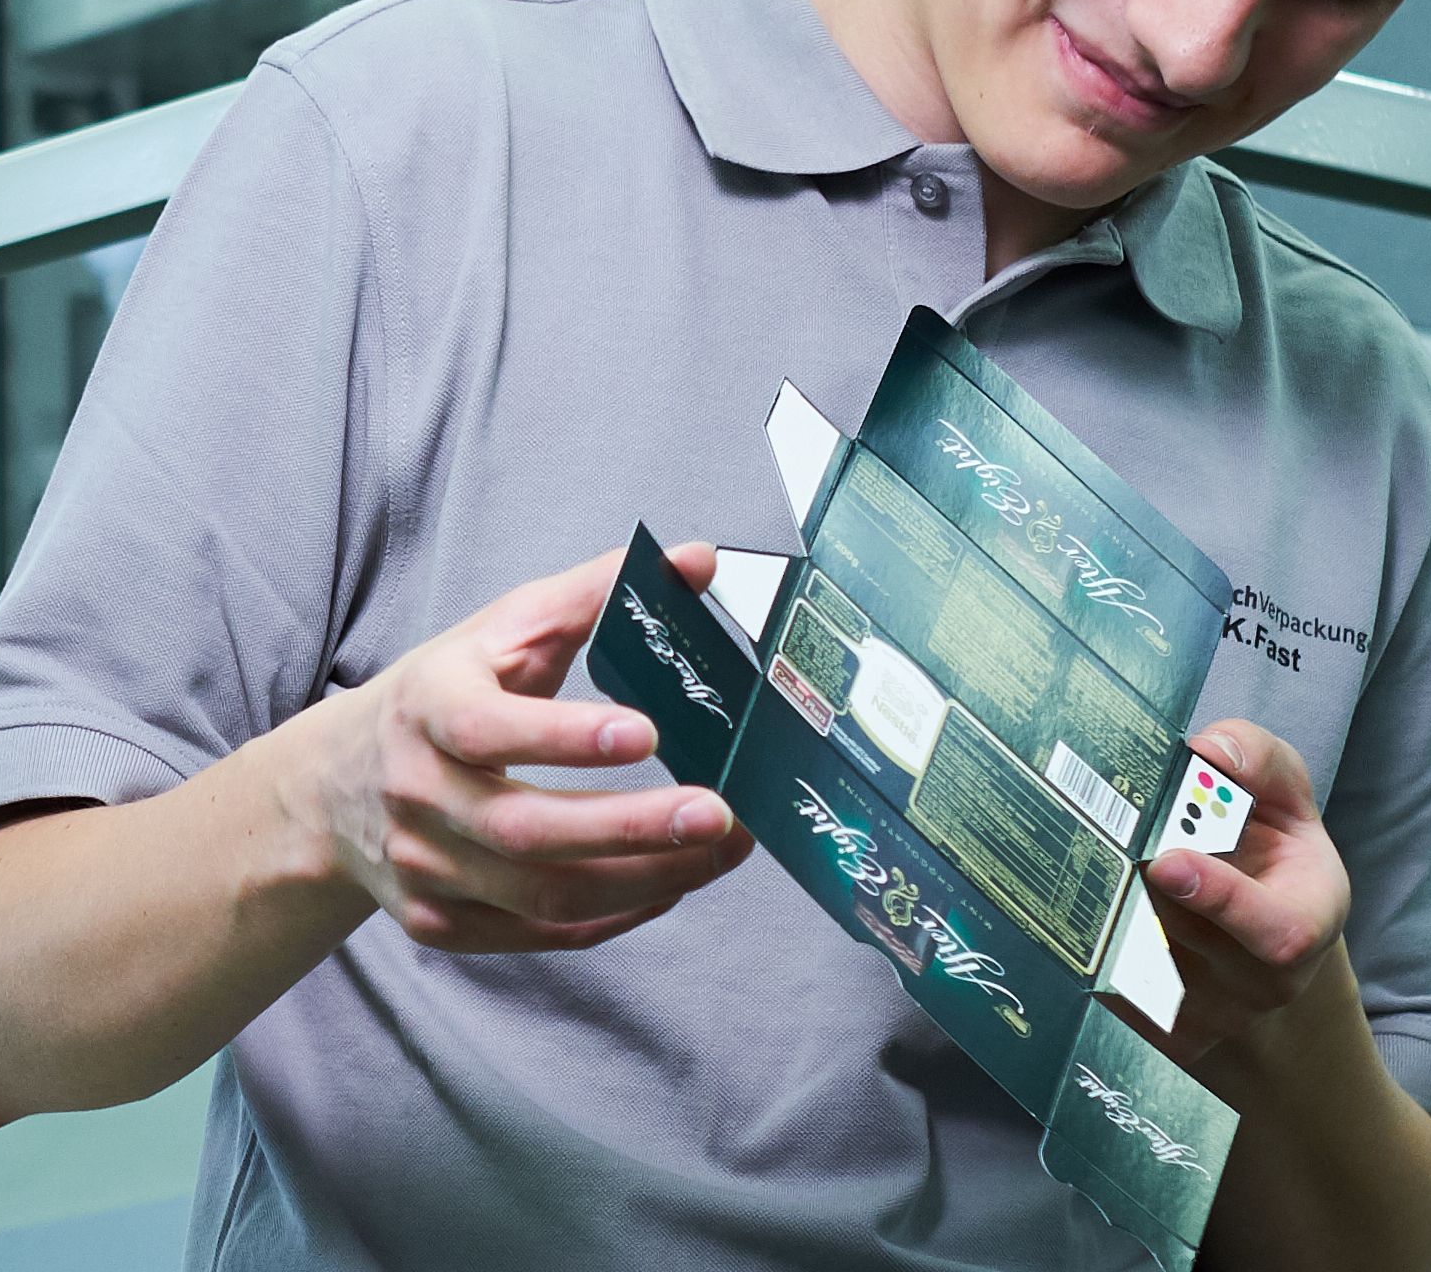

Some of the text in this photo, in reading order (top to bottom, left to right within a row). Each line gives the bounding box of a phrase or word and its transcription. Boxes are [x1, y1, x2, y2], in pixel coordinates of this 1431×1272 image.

[938, 419, 1029, 525] Eight
[1058, 535, 1163, 634] After
[1233, 585, 1369, 654] chVerpackung
[622, 584, 733, 729] After Eight
[796, 778, 887, 895] Eight
[913, 905, 1023, 1014] After
[1075, 1063, 1139, 1132] Eight
[1134, 1116, 1211, 1181] After
